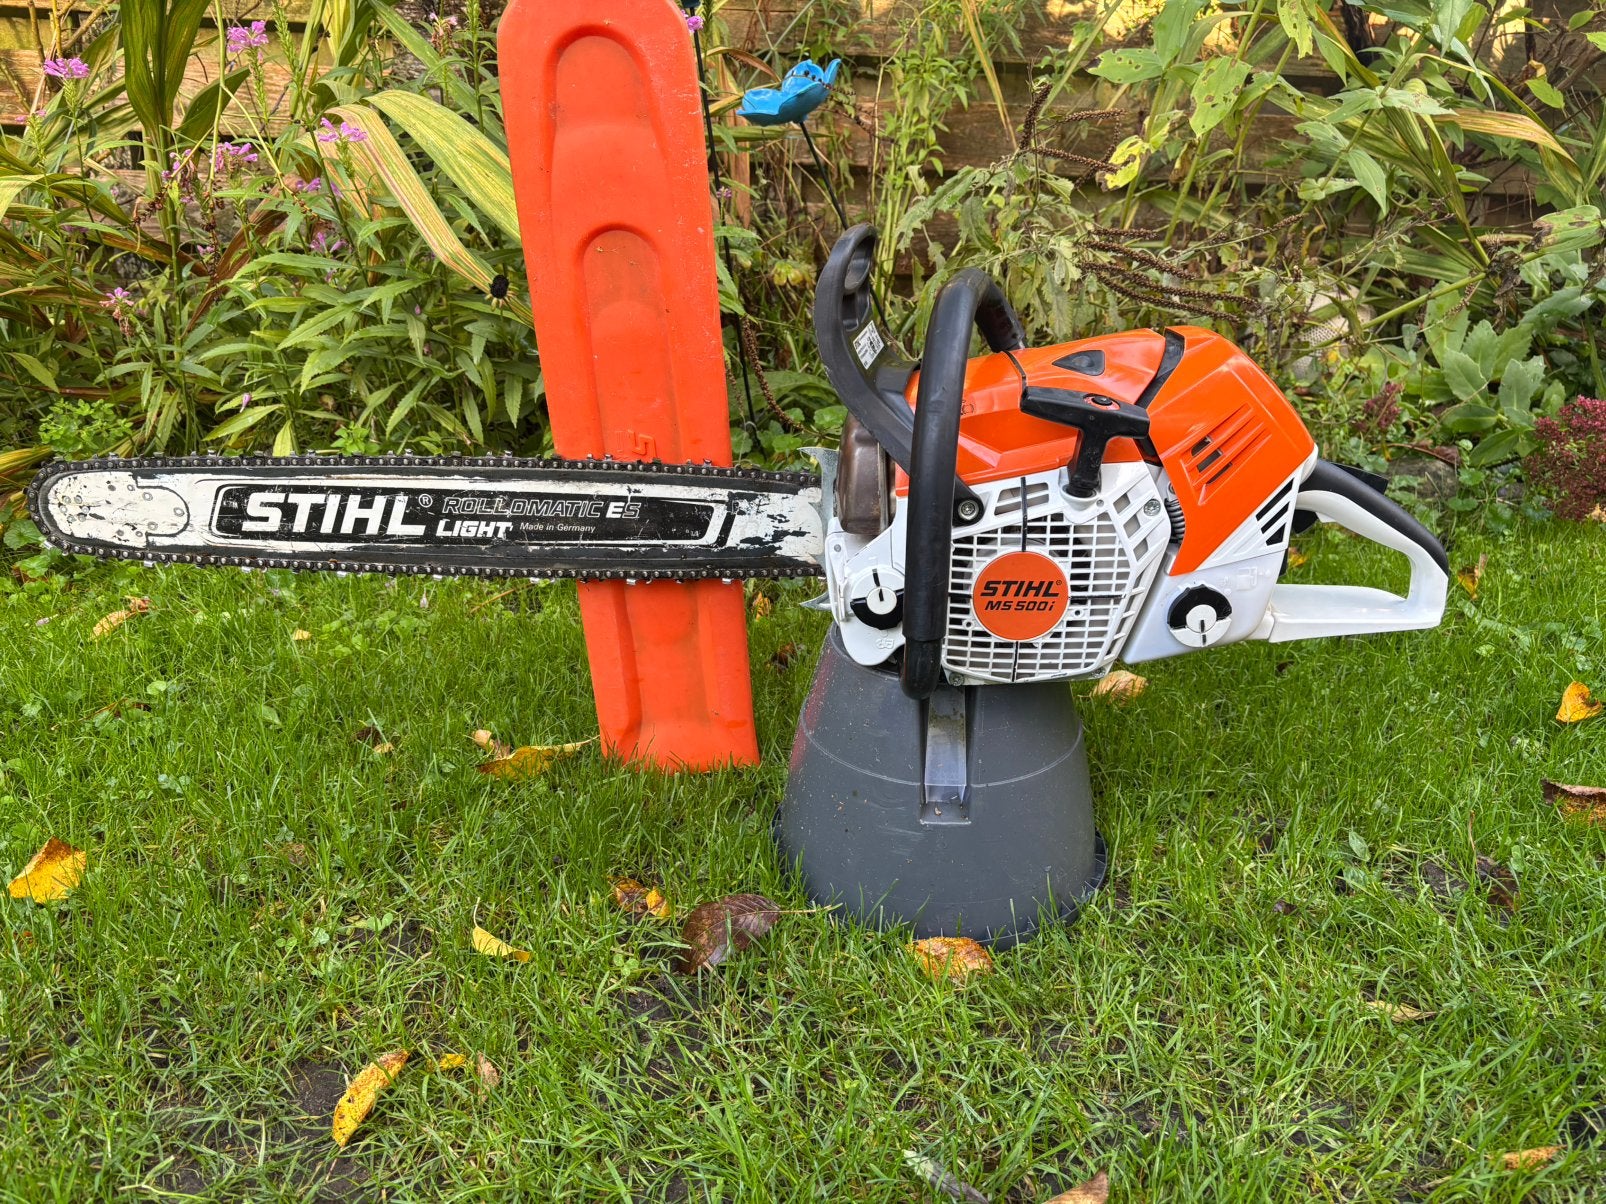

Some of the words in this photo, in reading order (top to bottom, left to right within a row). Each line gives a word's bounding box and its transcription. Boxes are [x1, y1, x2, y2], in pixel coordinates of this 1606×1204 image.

[442, 497, 603, 518] ROLLOMATIC
[605, 501, 642, 519] ES
[436, 519, 513, 538] LIGHT
[519, 522, 544, 532] Made
[546, 523, 555, 532] in
[557, 524, 596, 533] Germany
[985, 600, 1013, 611] MS
[1014, 600, 1056, 612] 500i
